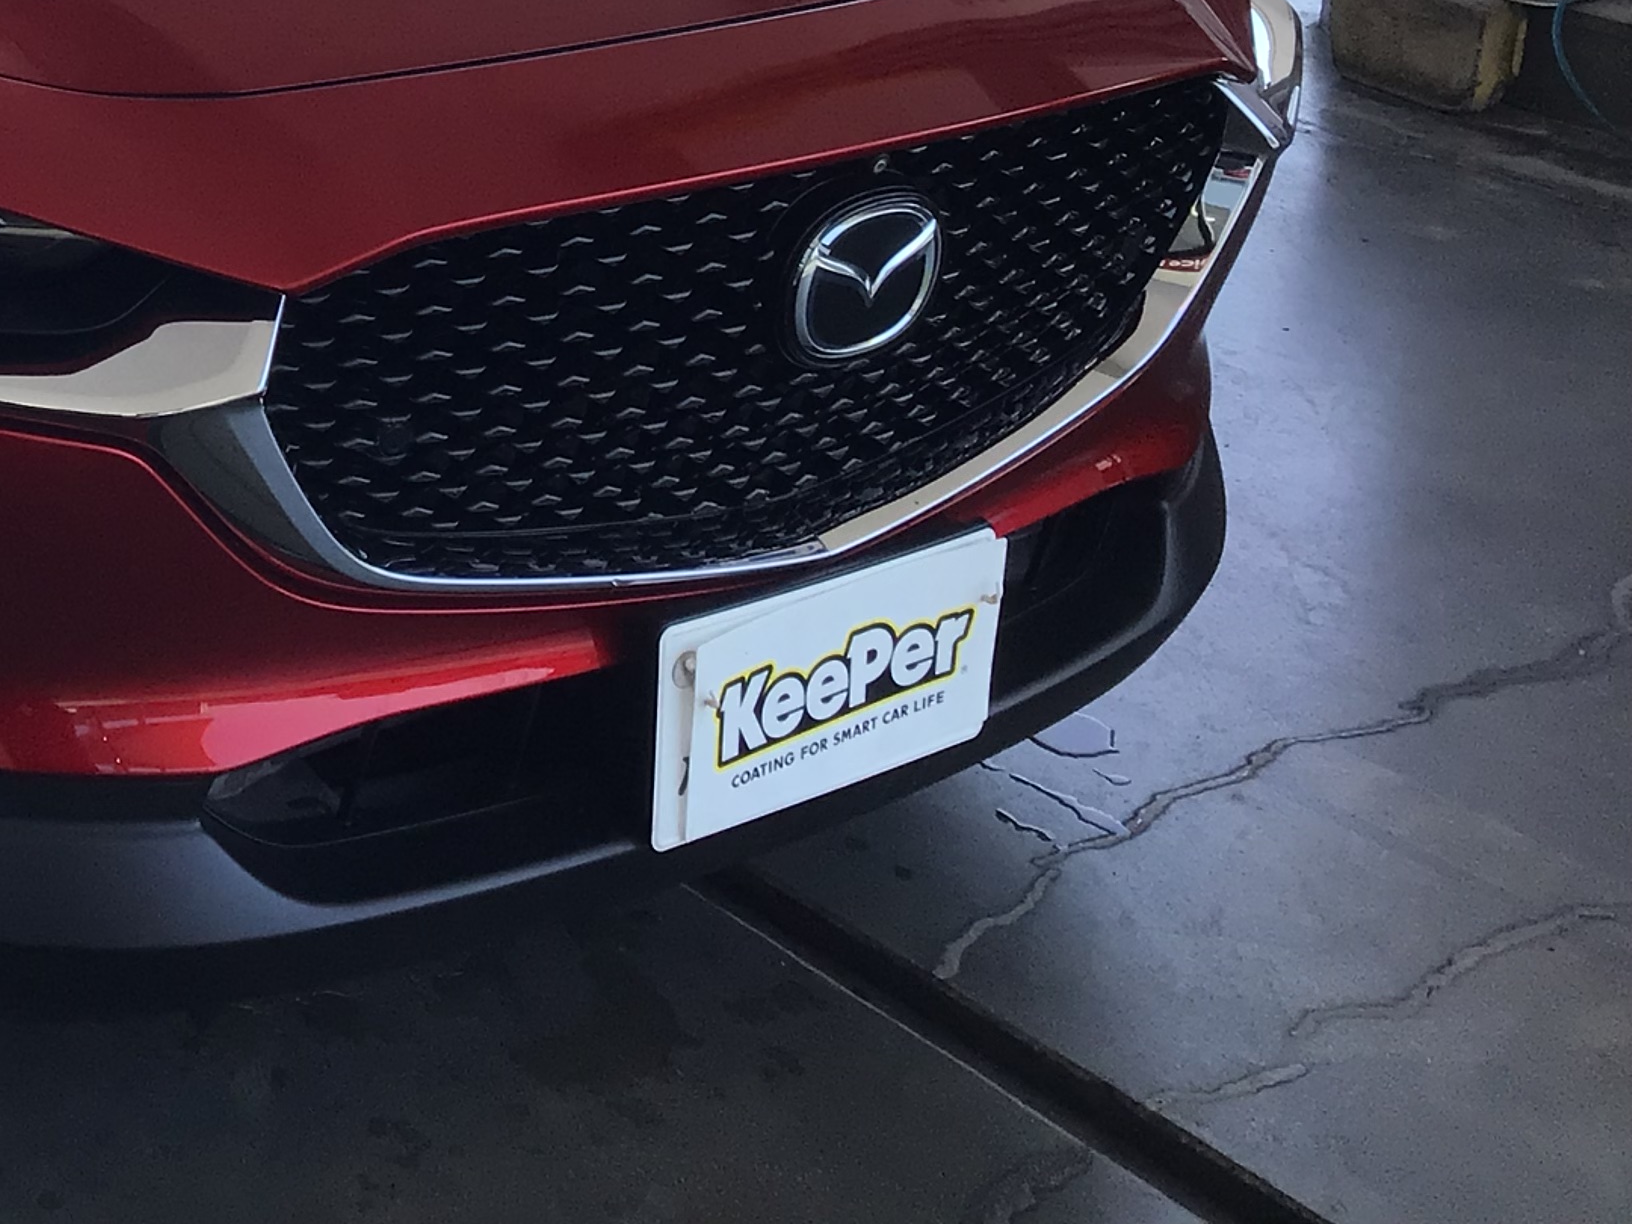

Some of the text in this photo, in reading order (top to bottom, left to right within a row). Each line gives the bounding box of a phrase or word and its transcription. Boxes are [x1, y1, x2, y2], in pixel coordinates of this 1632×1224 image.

[718, 607, 975, 768] KeePer
[731, 690, 946, 789] COATING FOR SMART CAR LIFE
